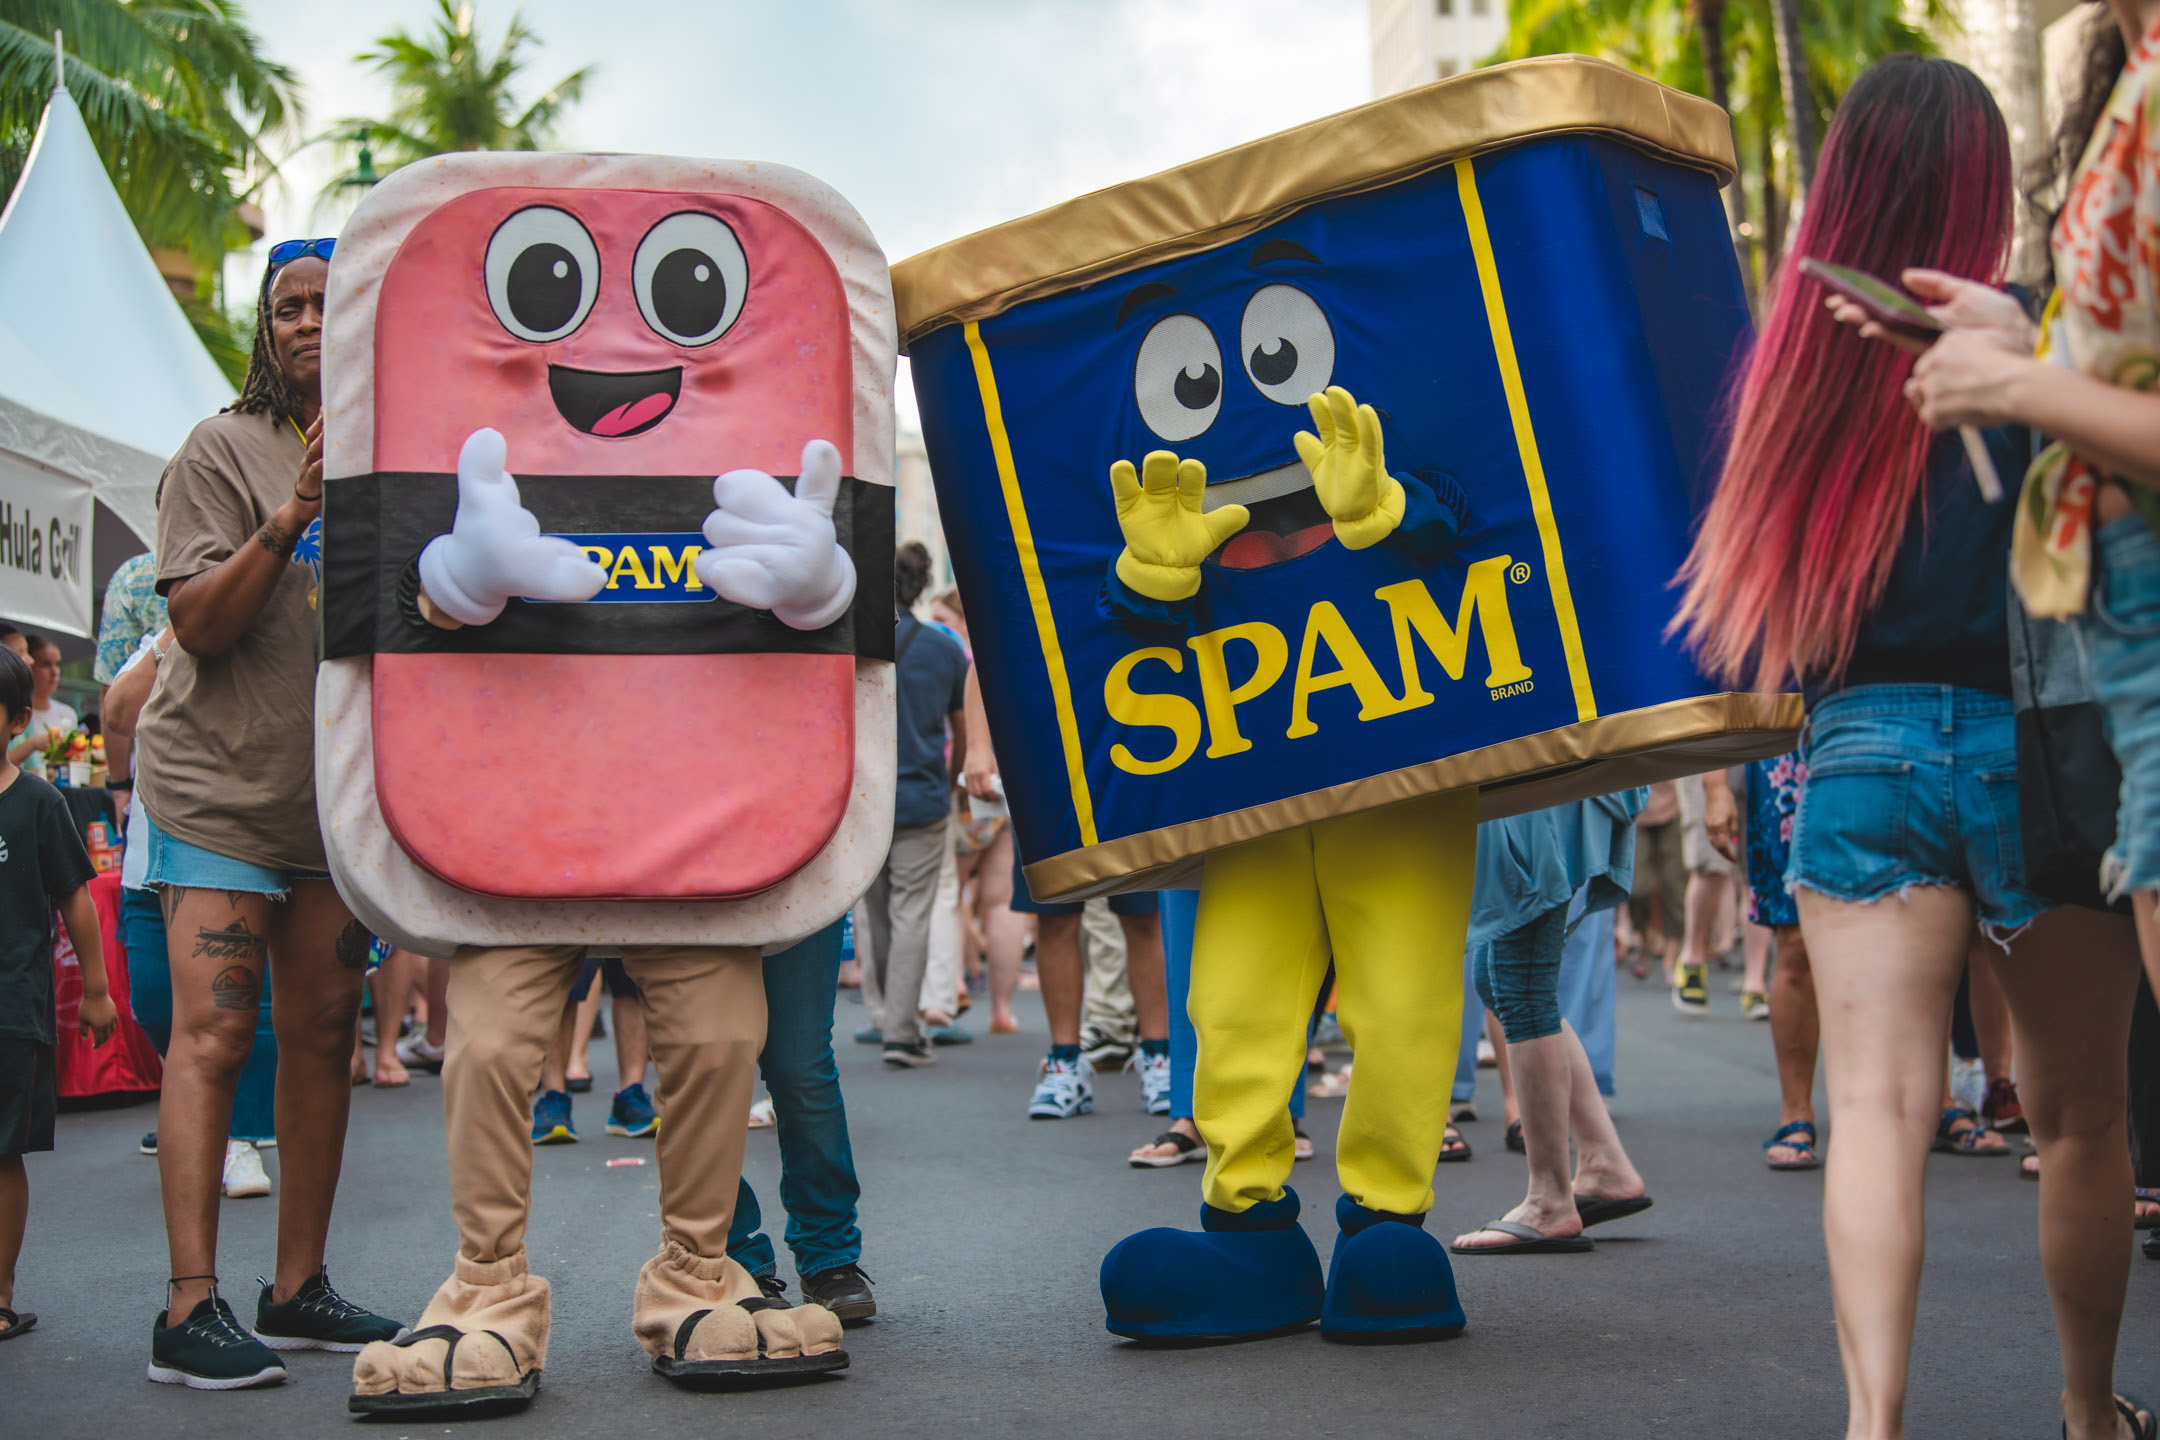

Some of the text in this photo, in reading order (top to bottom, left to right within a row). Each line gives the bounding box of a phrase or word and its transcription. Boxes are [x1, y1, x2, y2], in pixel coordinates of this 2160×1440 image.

[0, 499, 42, 576] Hula
[577, 545, 703, 589] PAM
[1490, 680, 1534, 701] BRAND
